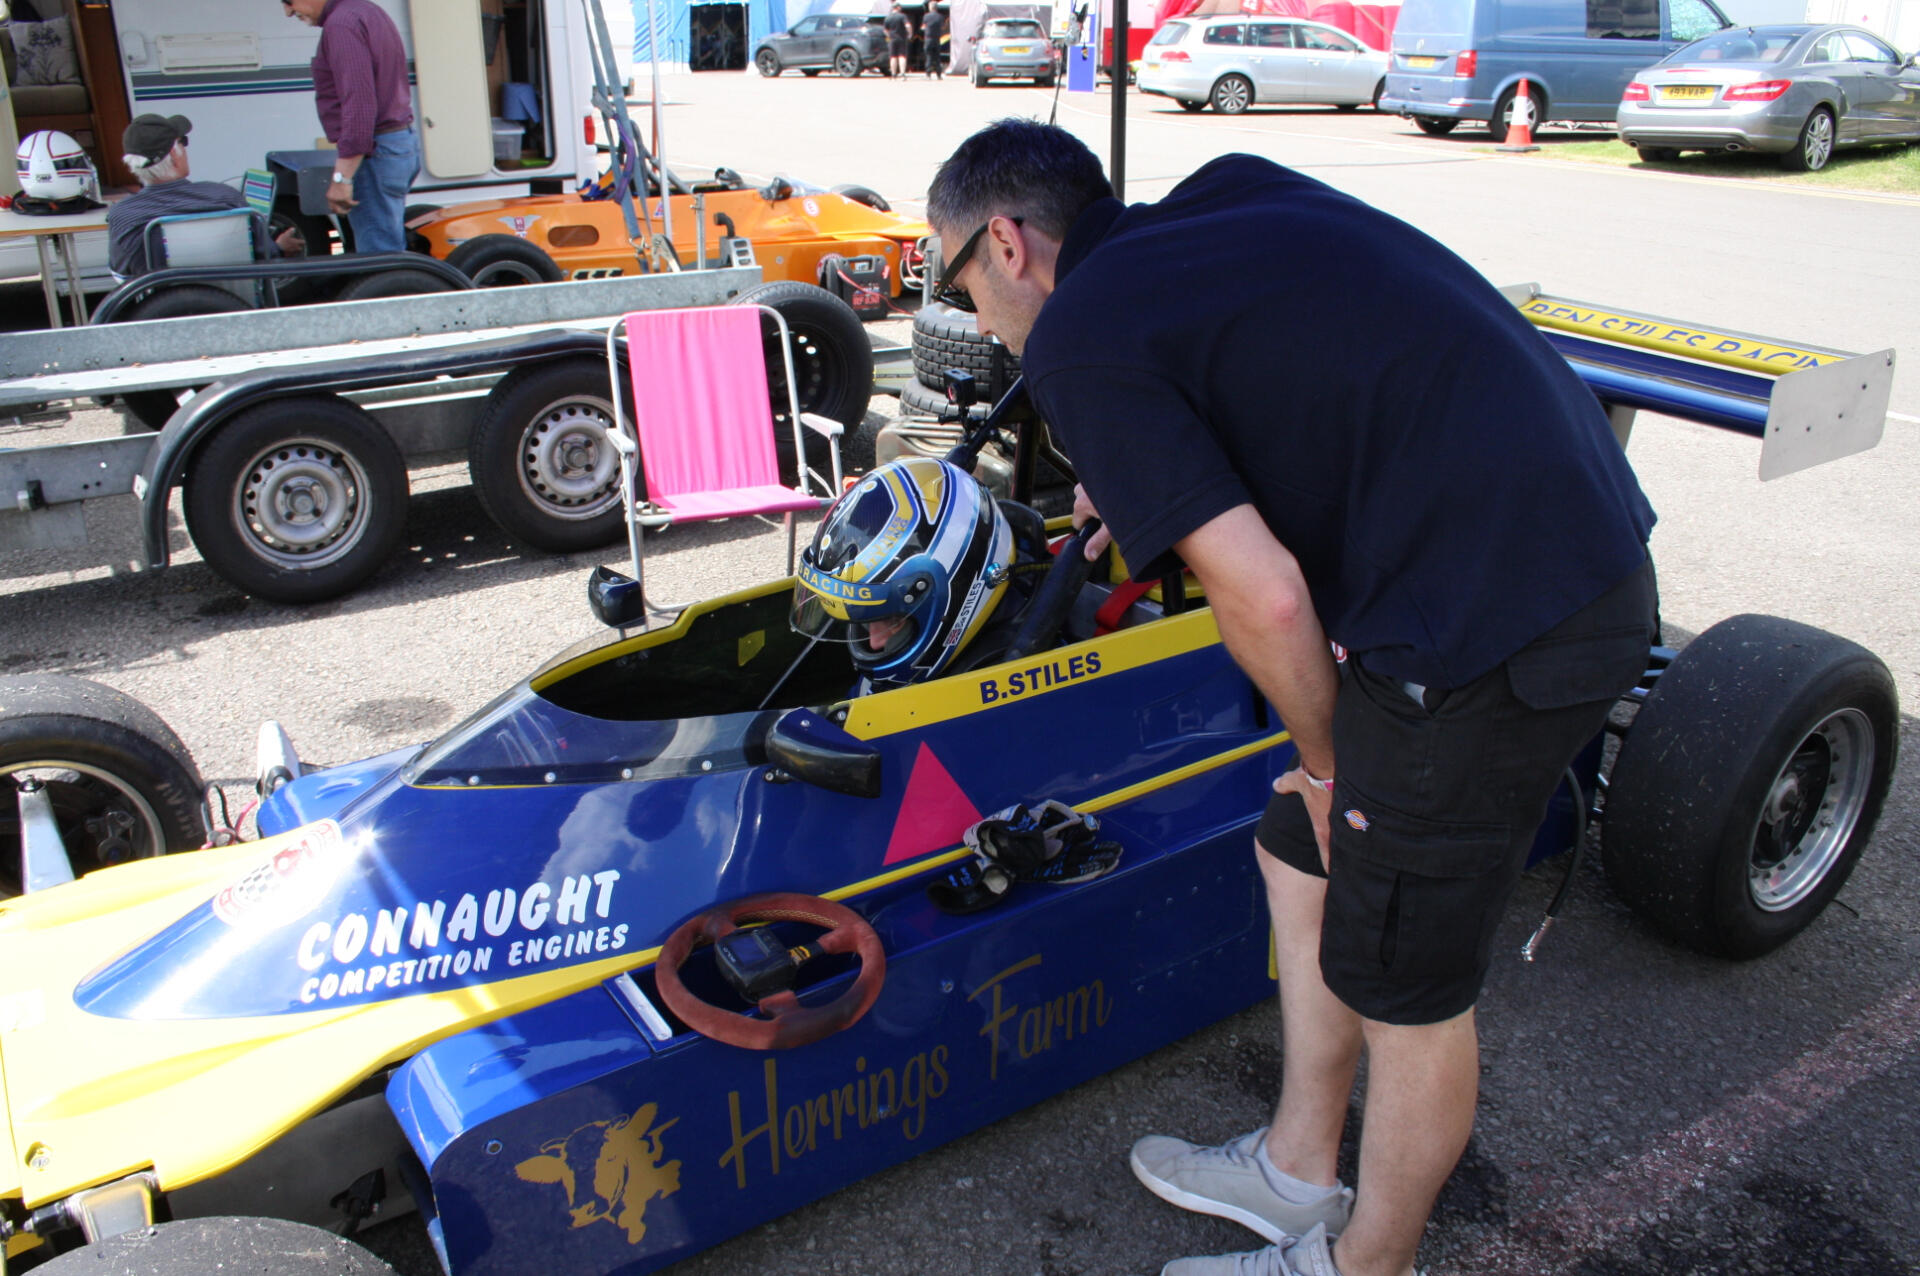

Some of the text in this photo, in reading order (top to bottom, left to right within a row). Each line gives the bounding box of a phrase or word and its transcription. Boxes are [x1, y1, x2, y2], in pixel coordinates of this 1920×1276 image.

[1710, 339, 1822, 369] RACIN
[802, 566, 873, 600] RACING
[961, 582, 982, 617] STILES
[979, 651, 1102, 705] B.STILES
[297, 869, 621, 971] CONNAUGHT
[300, 923, 630, 1004] COMPETITION ENGINES
[718, 953, 1113, 1189] Herrings Farm
